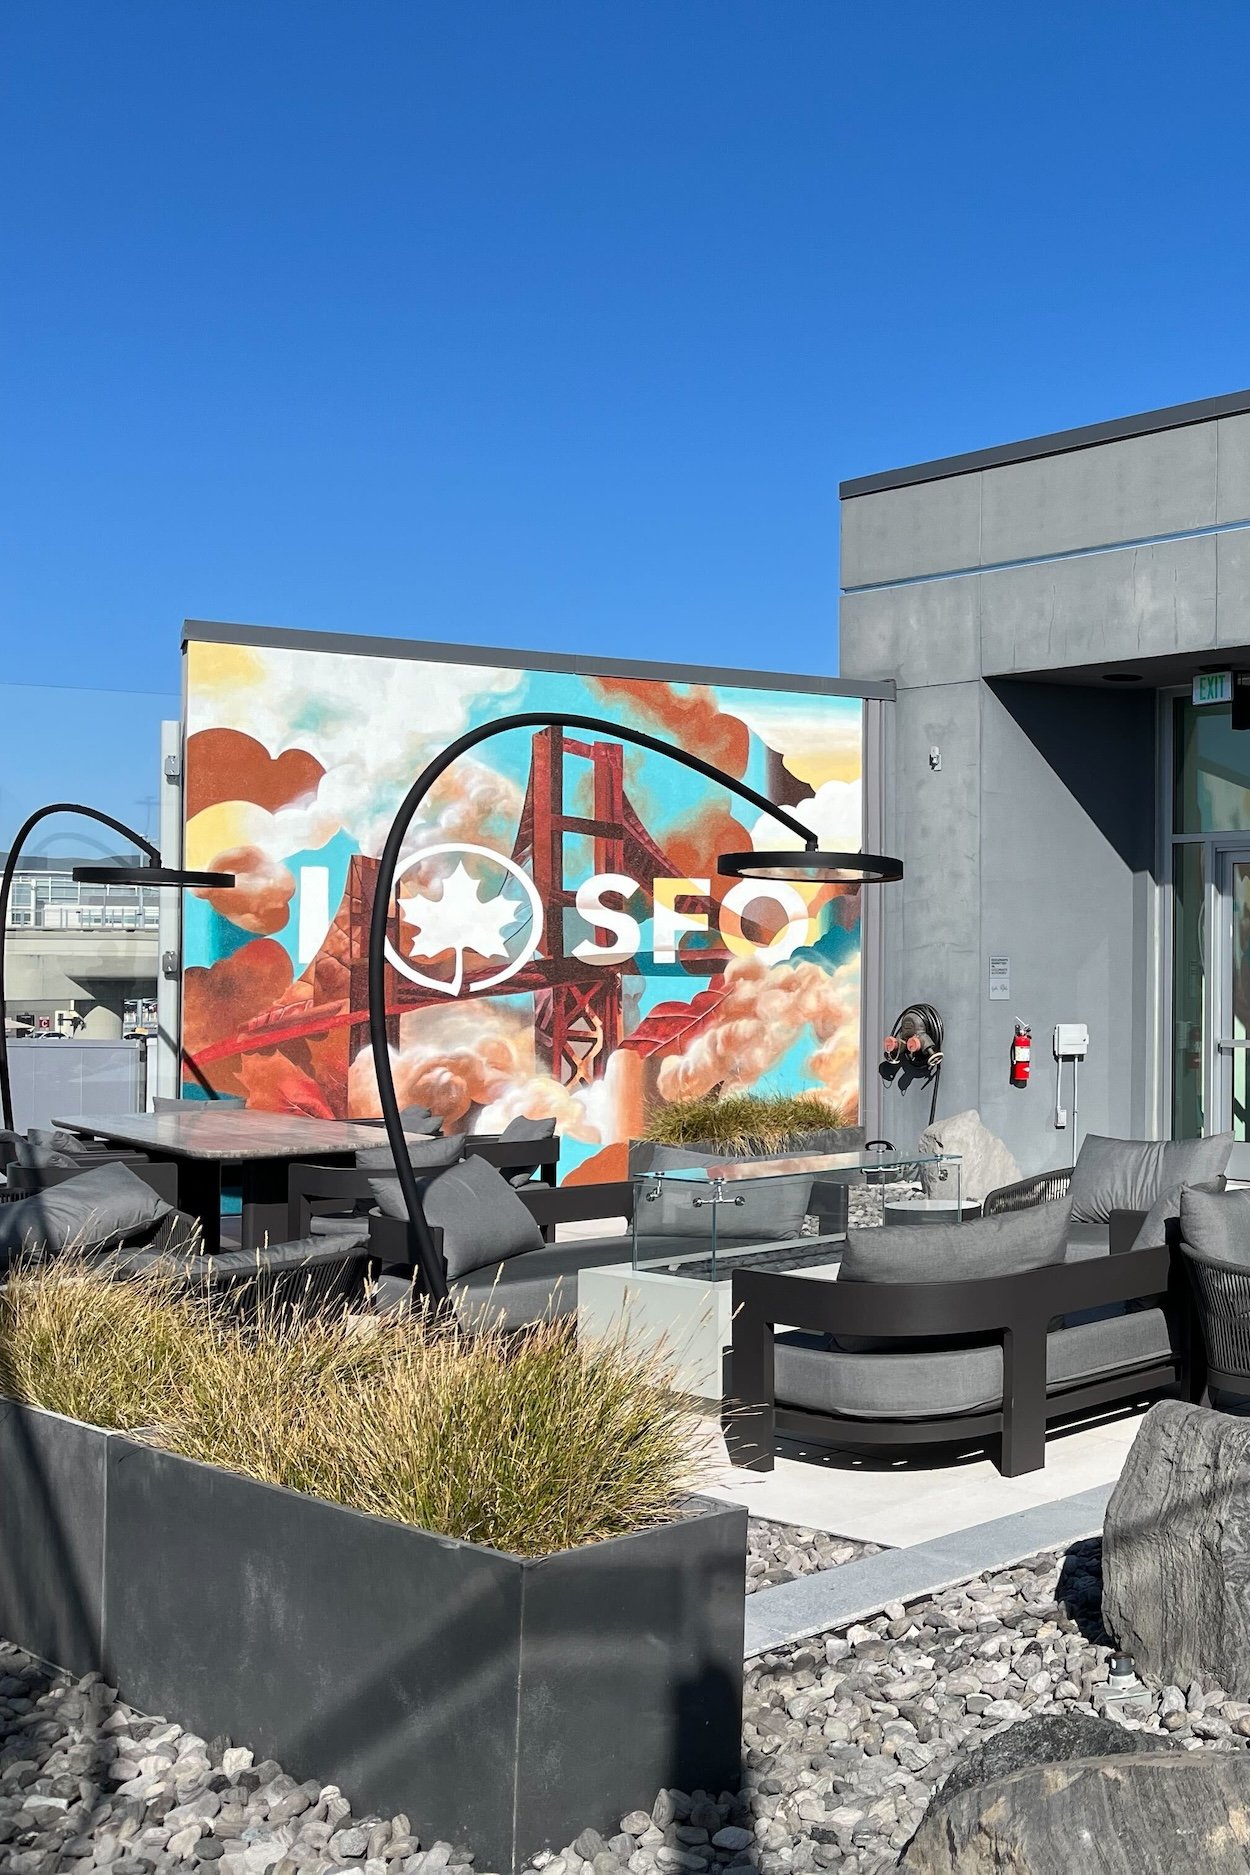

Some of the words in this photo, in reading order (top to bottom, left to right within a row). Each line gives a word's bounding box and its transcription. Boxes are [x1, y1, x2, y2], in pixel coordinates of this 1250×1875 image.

[1200, 674, 1225, 700] EXIT
[299, 866, 329, 964] I
[571, 873, 809, 967] SFO
